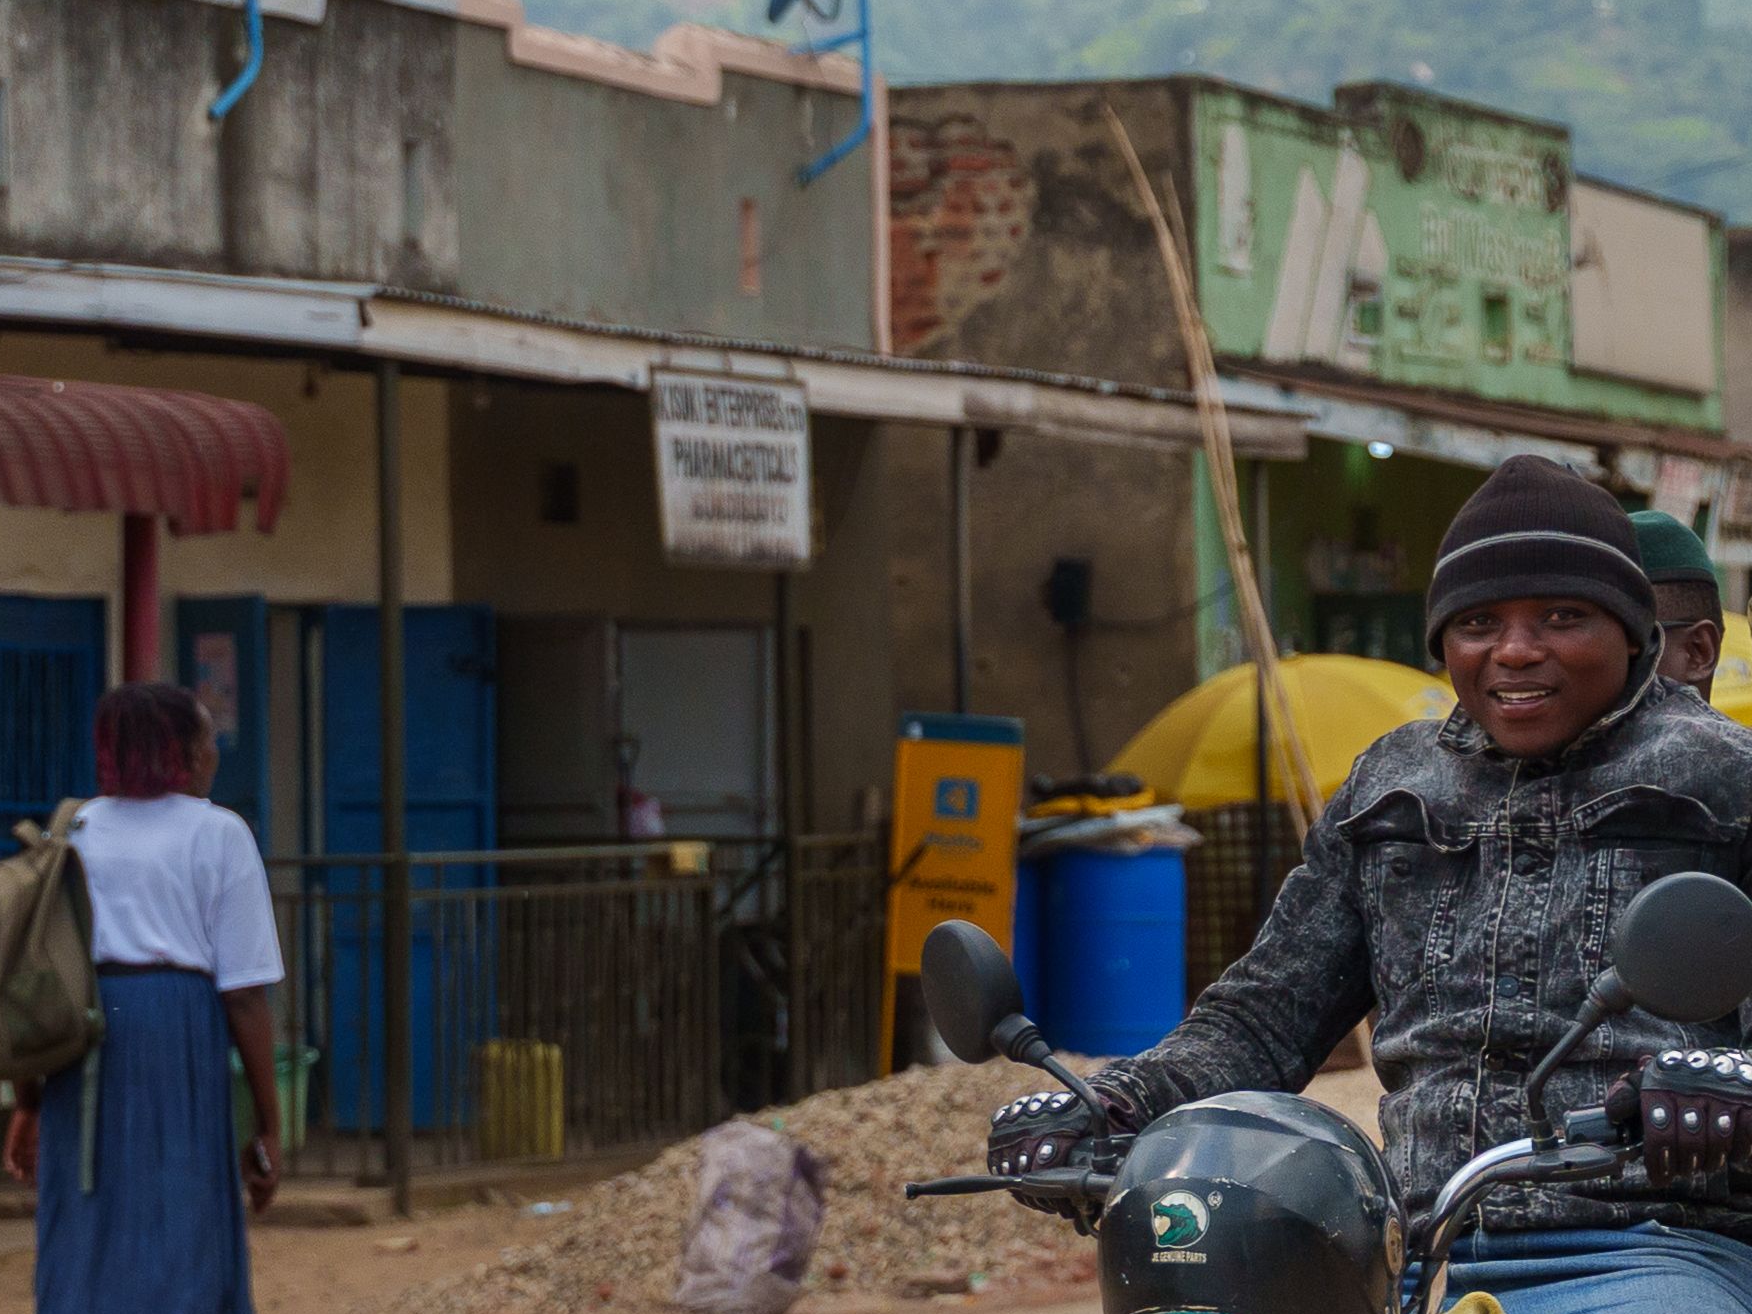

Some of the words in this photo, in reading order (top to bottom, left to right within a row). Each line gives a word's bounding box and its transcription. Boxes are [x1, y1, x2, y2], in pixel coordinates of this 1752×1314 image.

[673, 437, 799, 483] PHARMACEUTICALS
[1160, 1250, 1186, 1262] GENUINE
[1186, 1251, 1207, 1263] PARTS
